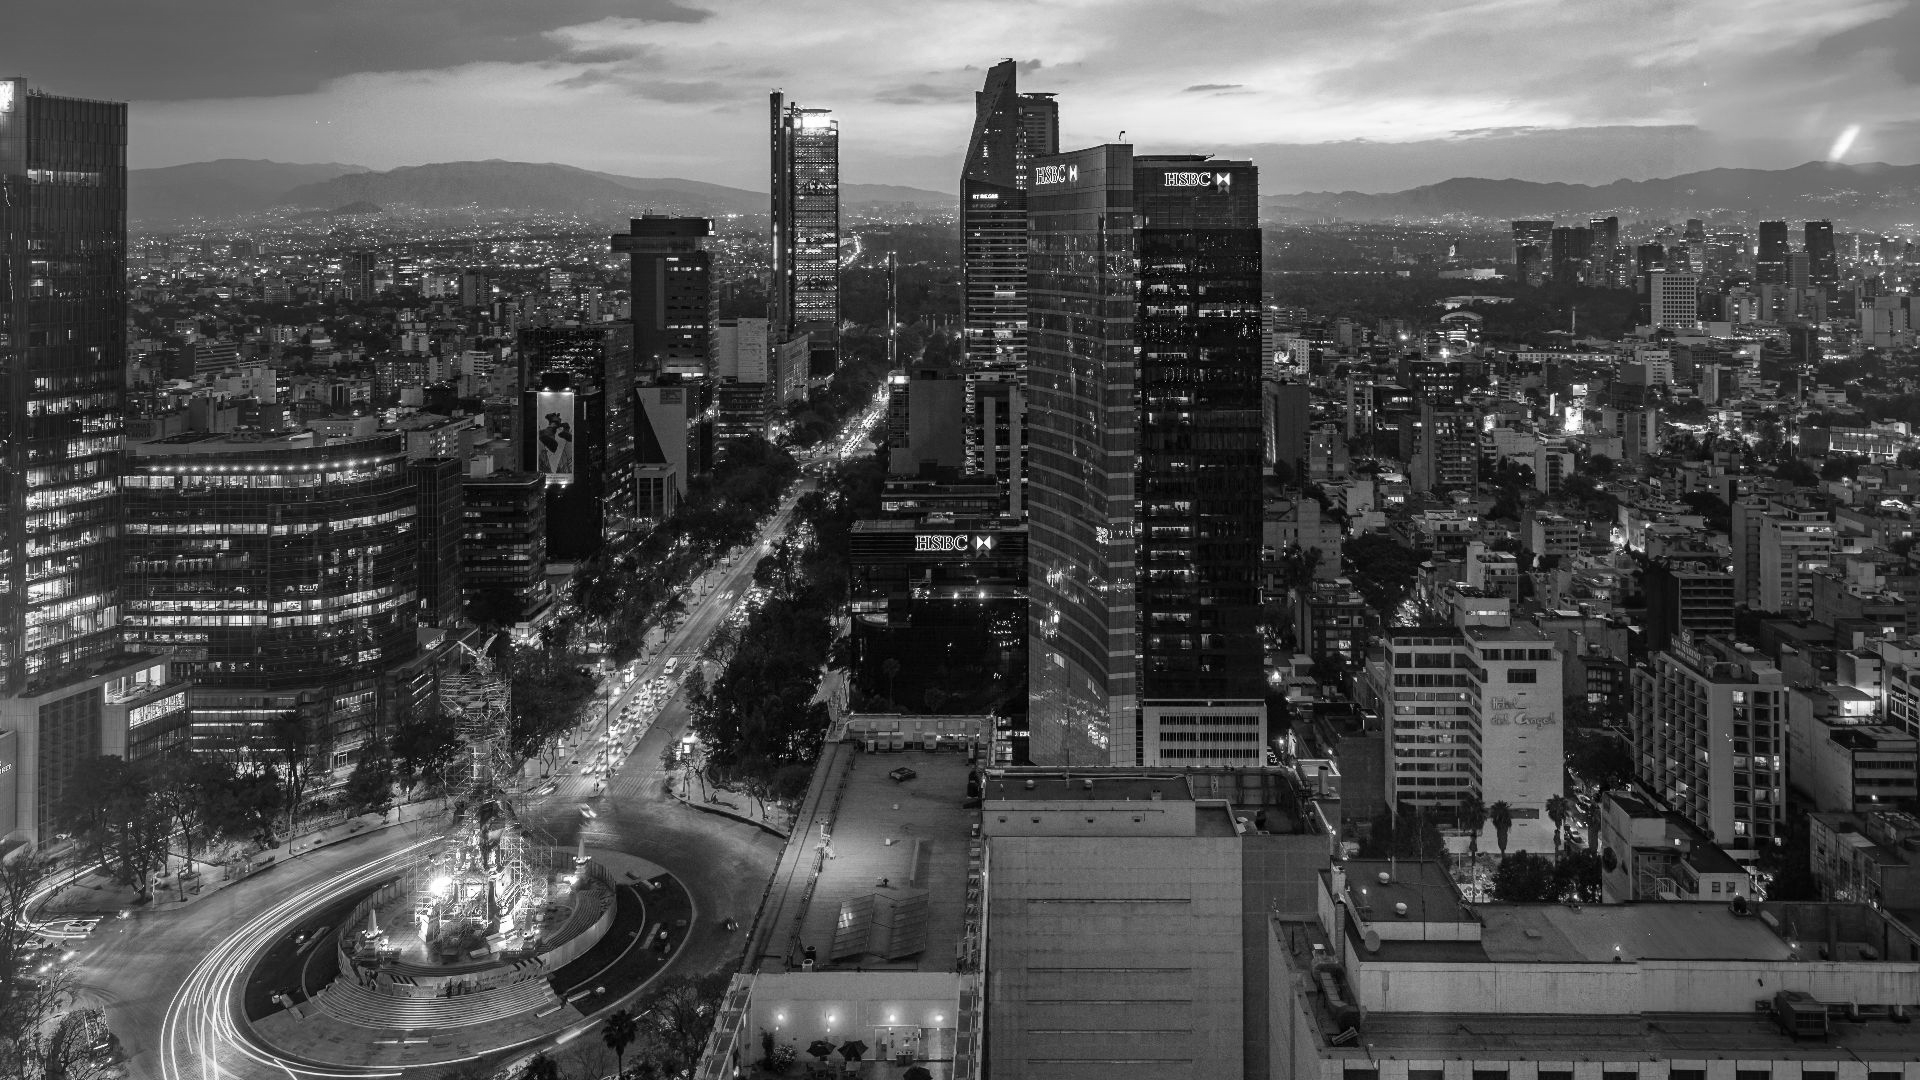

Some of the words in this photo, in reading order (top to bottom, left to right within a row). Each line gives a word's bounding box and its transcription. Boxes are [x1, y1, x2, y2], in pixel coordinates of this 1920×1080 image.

[1035, 164, 1066, 185] HSBC
[1164, 172, 1211, 187] HSBC
[914, 534, 968, 551] HSBC
